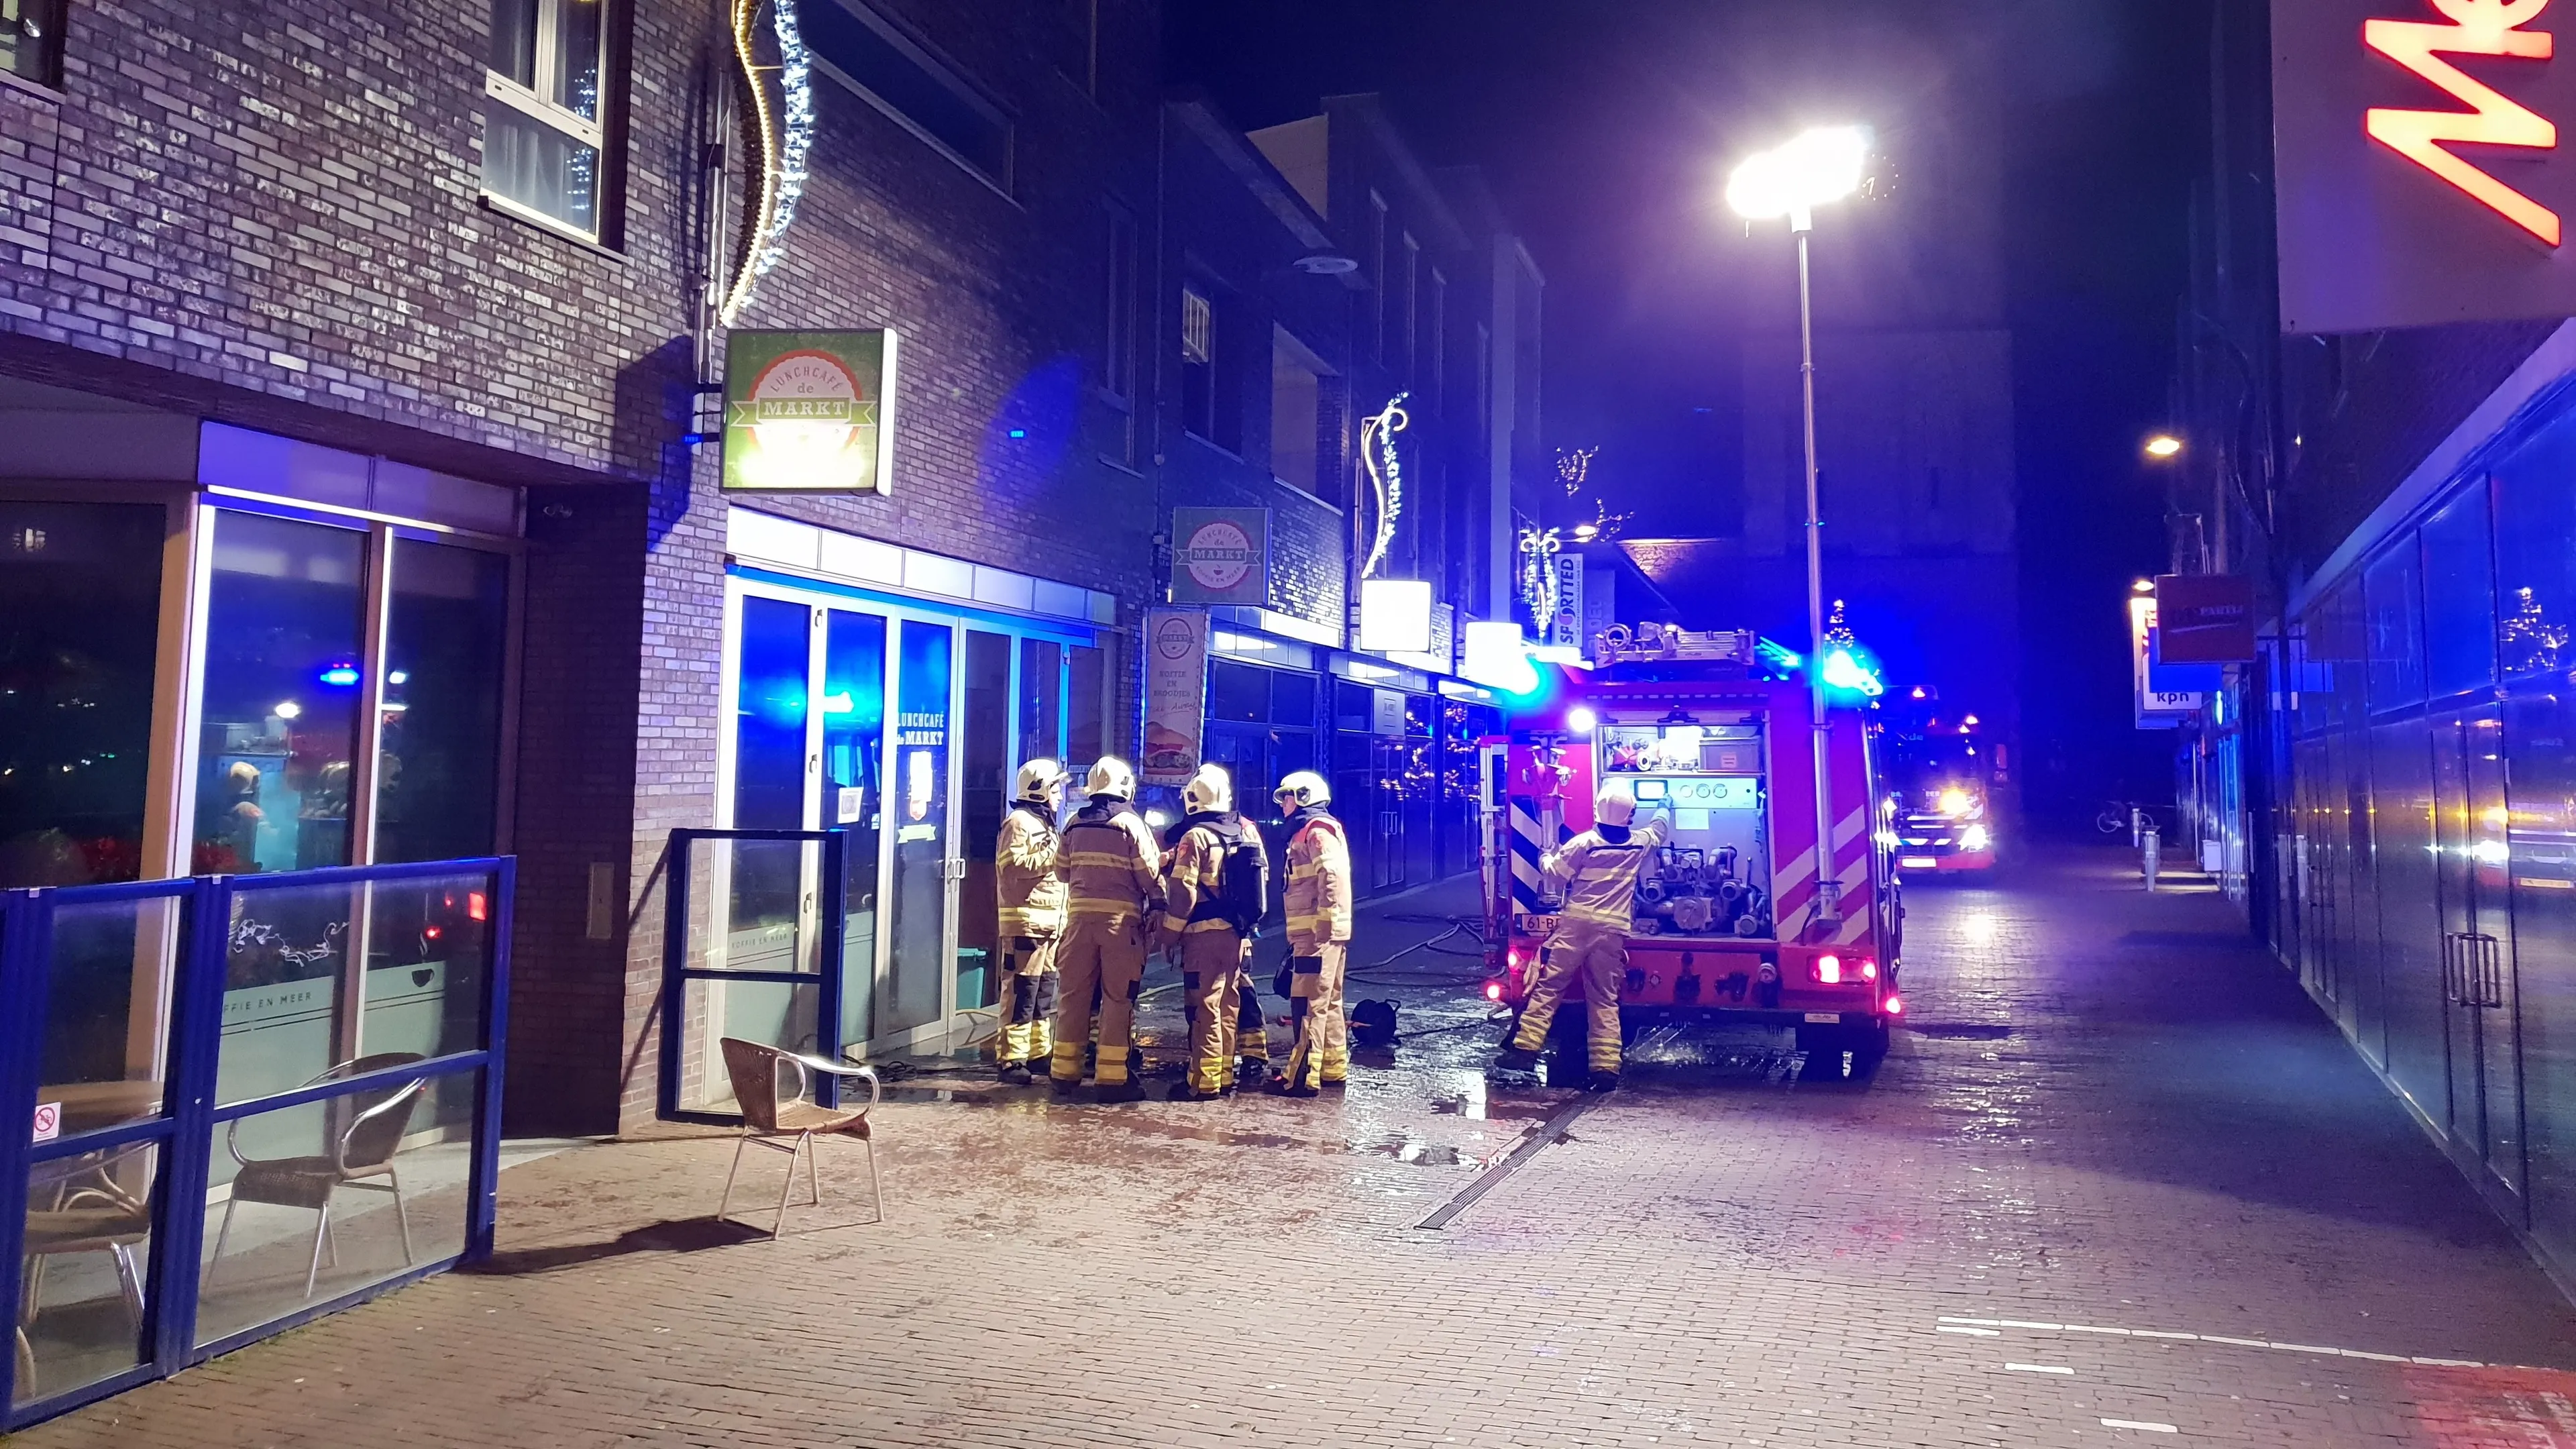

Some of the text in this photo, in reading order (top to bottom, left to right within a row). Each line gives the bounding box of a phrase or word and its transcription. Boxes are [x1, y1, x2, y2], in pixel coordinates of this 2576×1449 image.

[797, 382, 814, 394] de
[763, 401, 845, 416] MARKT
[1194, 550, 1243, 559] MARKT
[1558, 558, 1576, 644] SPORTTED
[2157, 692, 2189, 705] kpn
[905, 731, 944, 745] MARKT
[258, 998, 274, 1008] EN
[280, 991, 312, 1005] MEER
